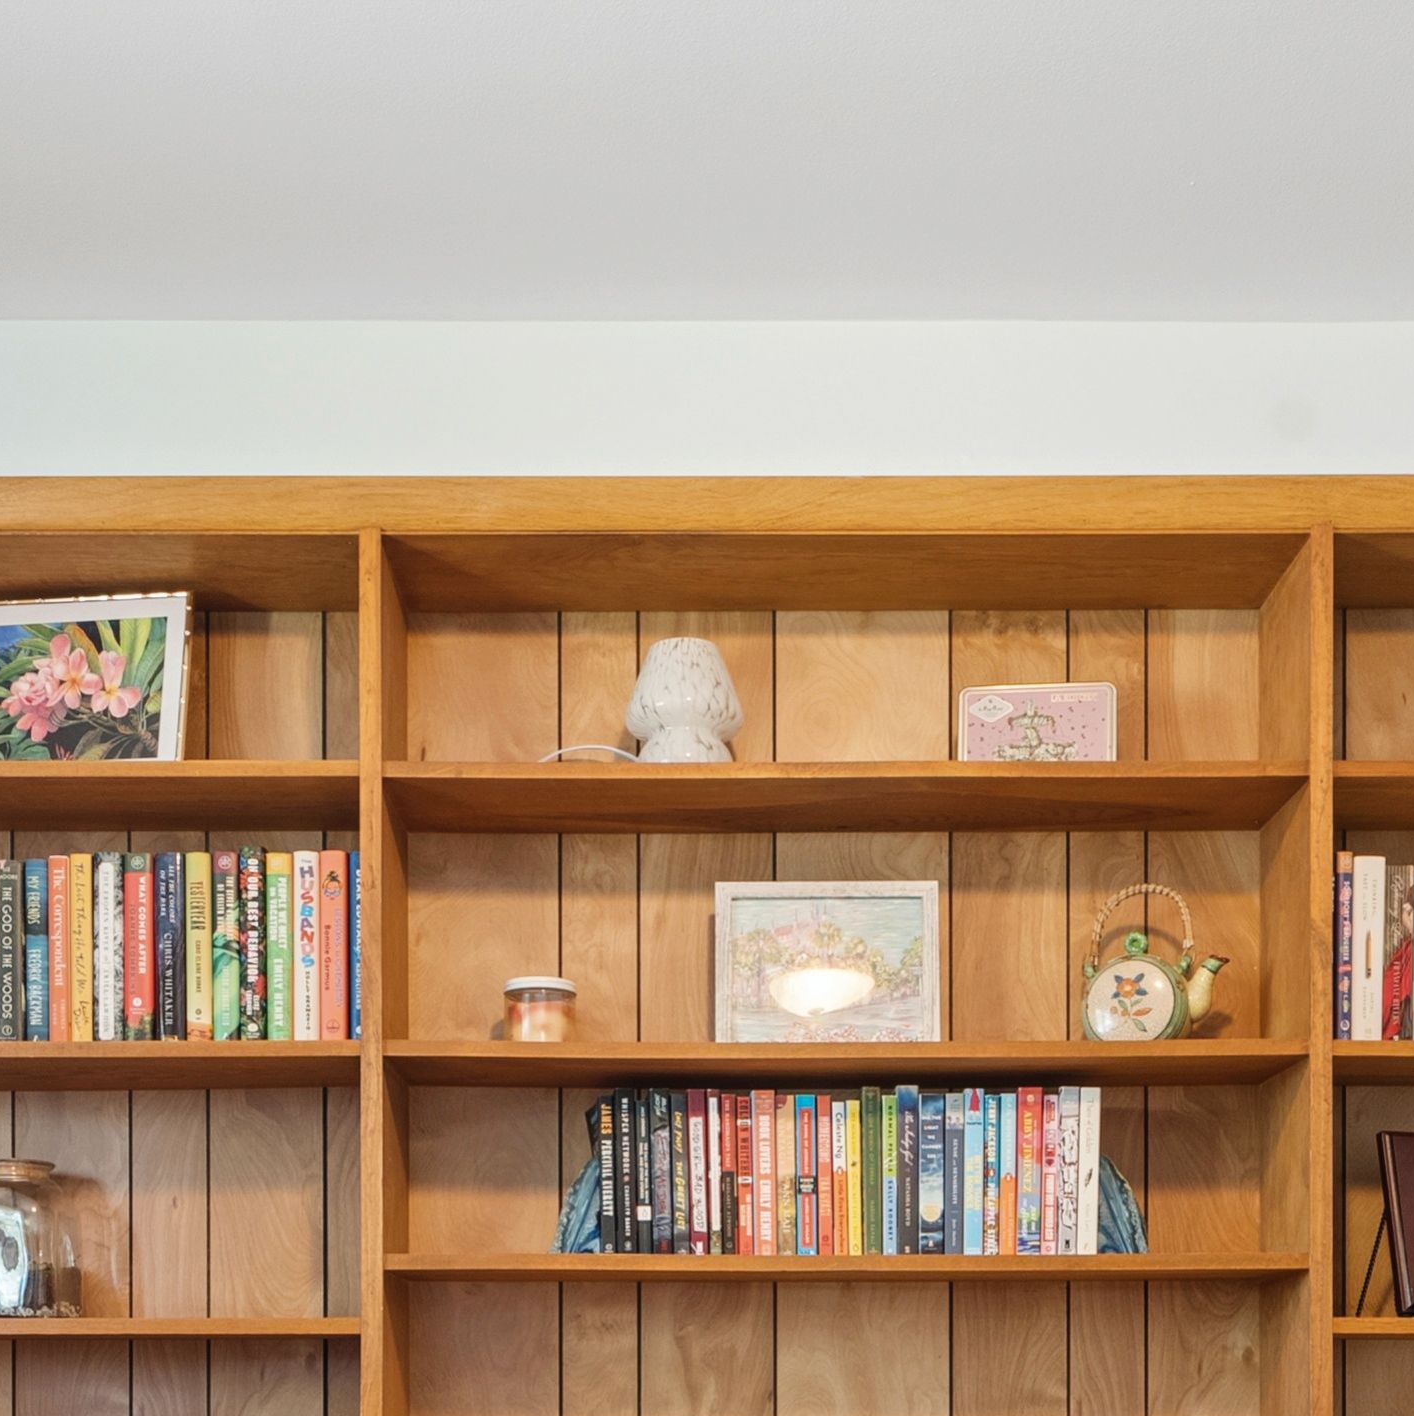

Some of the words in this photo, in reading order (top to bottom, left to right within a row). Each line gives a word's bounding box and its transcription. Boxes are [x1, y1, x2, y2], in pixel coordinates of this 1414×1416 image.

[52, 867, 65, 889] The
[247, 858, 259, 872] ON
[1, 887, 12, 901] THE
[26, 875, 40, 888] MY
[138, 876, 147, 902] WHAT
[247, 877, 259, 898] OUR
[1, 904, 12, 933] GOD
[26, 892, 40, 925] FRIENDS
[190, 882, 207, 931] YESTERYEAR
[247, 902, 259, 928] BEST
[298, 866, 315, 968] HUSBANDS
[138, 908, 147, 940] COMES
[324, 925, 332, 954] Bonnie
[1, 936, 12, 950] OF
[51, 894, 66, 987] Correspondent
[163, 933, 173, 965] CHRIS
[1, 954, 12, 968] THE
[28, 950, 43, 982] FREDRIK
[138, 943, 147, 974] AFTER
[247, 931, 259, 982] BEHAVIOR
[273, 959, 284, 989] EMILY
[324, 957, 332, 991] Garmus
[1, 972, 12, 1020] WOODS
[28, 985, 43, 1026] BACKMAN
[163, 969, 173, 1025] WHITAKER
[273, 993, 284, 1026] HENRY
[601, 1104, 612, 1134] JAMES
[621, 1098, 629, 1132] WHISPER
[987, 1099, 996, 1123] JENNY
[1022, 1111, 1032, 1140] ABBY
[759, 1115, 771, 1139] BOOK
[834, 1112, 843, 1142] Celeste
[602, 1140, 613, 1177] PERCIVAL
[622, 1137, 630, 1173] NETWORK
[759, 1142, 771, 1174] LOVERS
[834, 1145, 843, 1159] Ng
[987, 1125, 996, 1162] JACKSON
[1022, 1143, 1032, 1192] JIMENEZ
[602, 1180, 613, 1216] EVERETT
[676, 1177, 685, 1210] GUEST
[760, 1180, 772, 1208] EMILY
[781, 1183, 791, 1203] ANN
[987, 1183, 997, 1226] PINEAPPLE
[676, 1212, 685, 1230] LIST
[760, 1211, 772, 1241] HENRY
